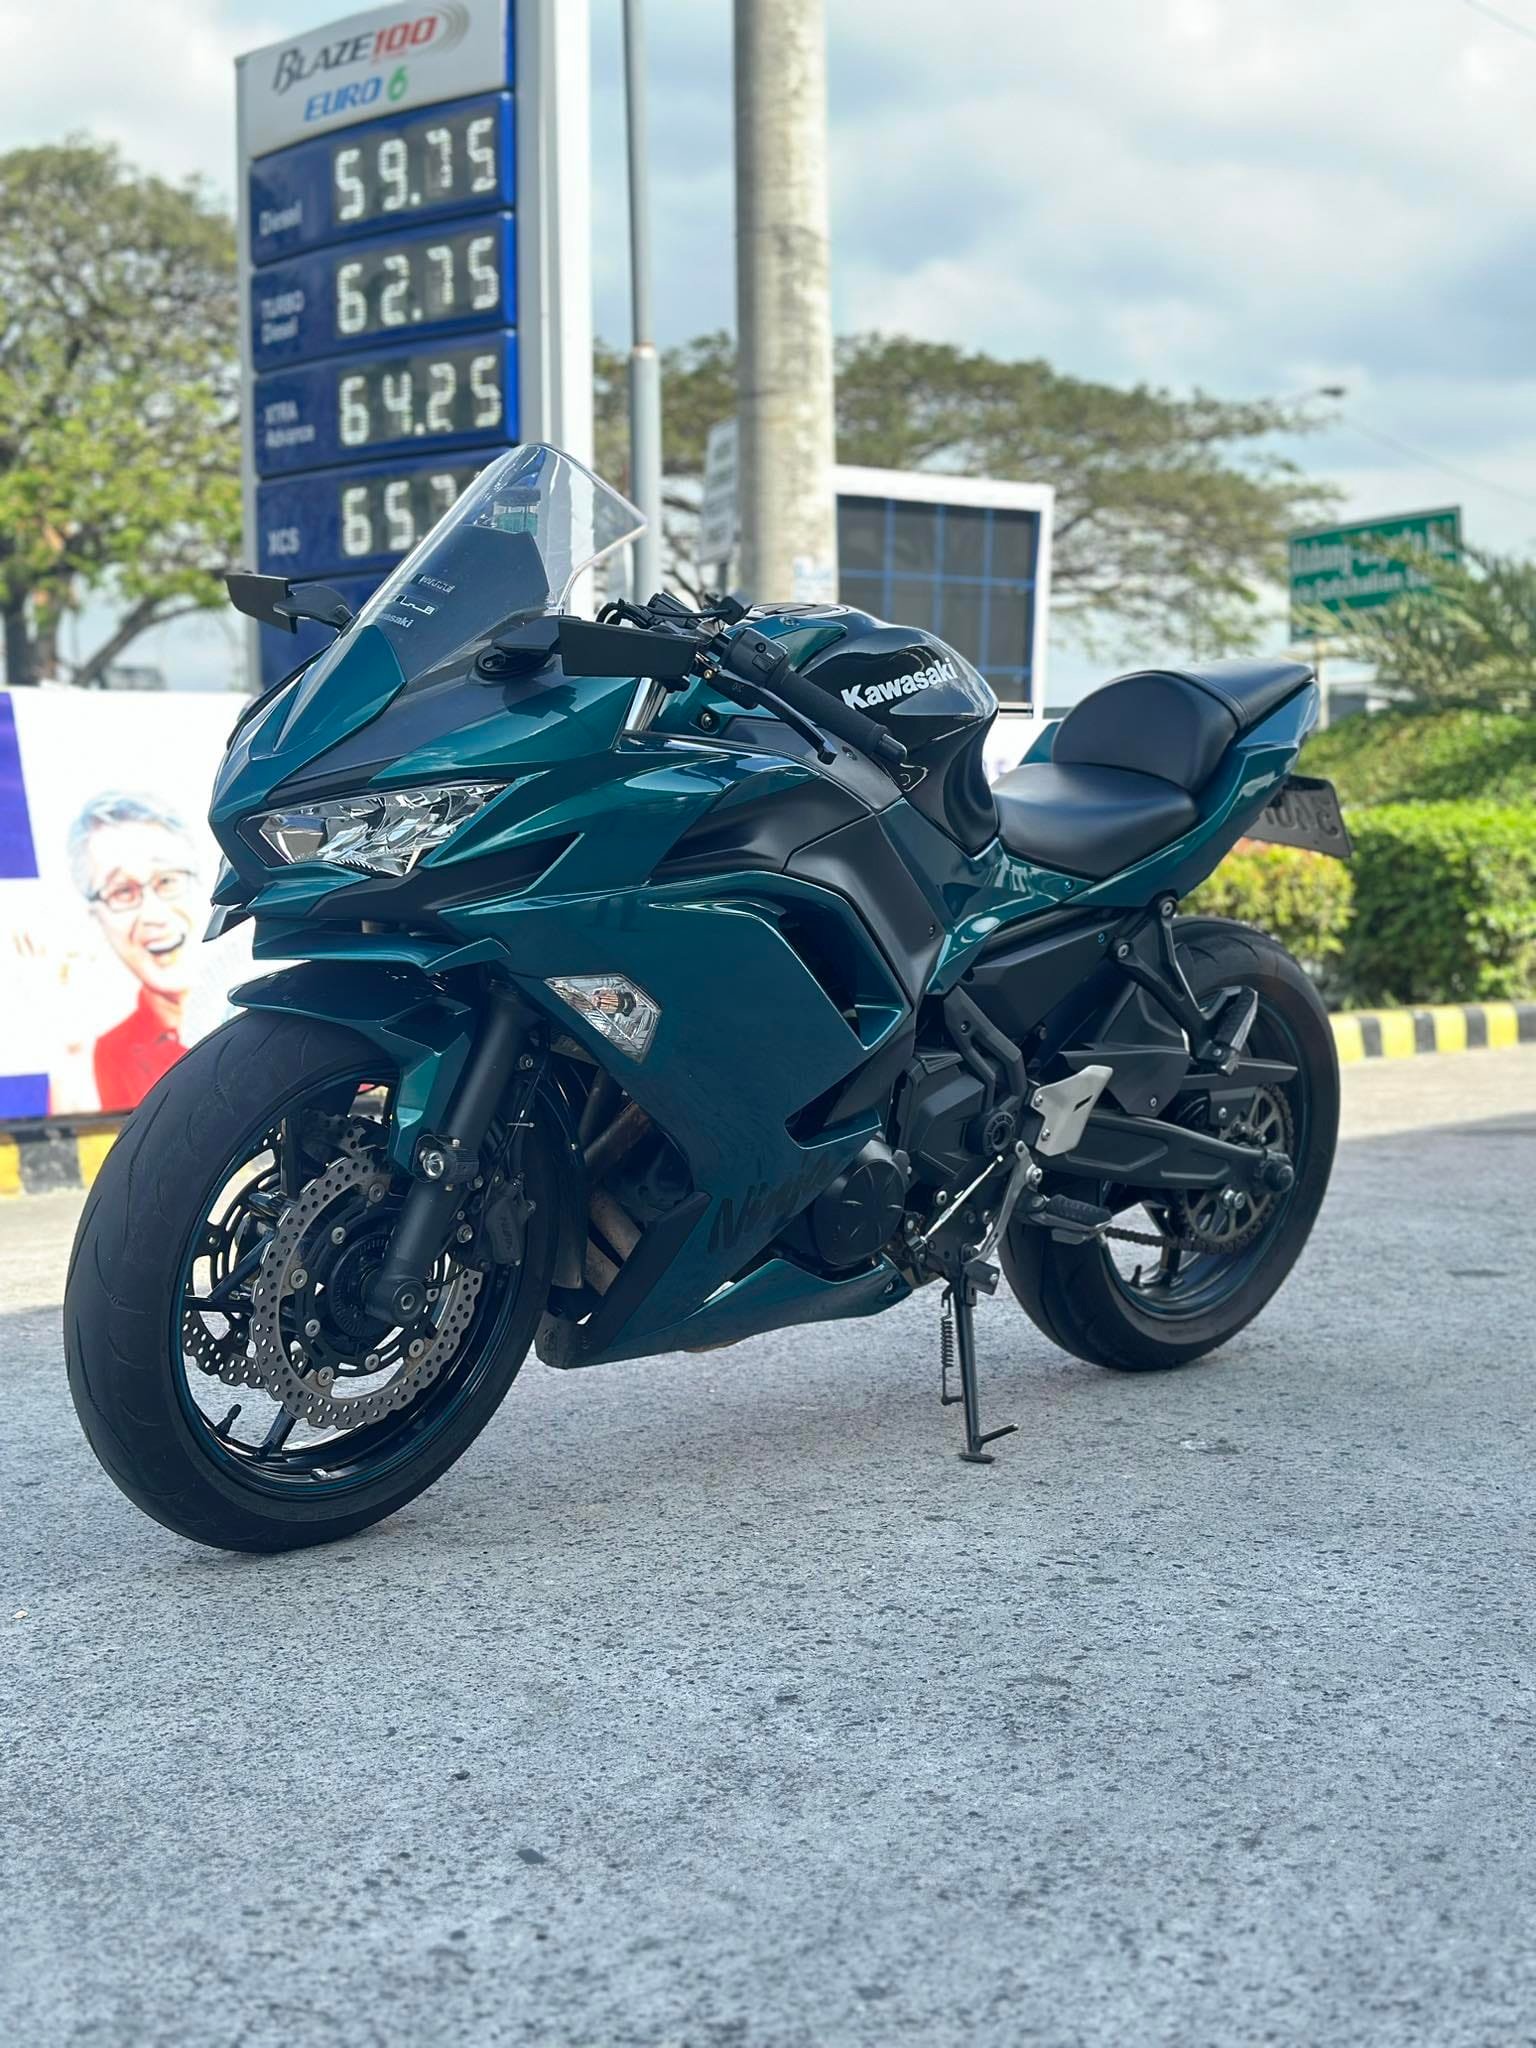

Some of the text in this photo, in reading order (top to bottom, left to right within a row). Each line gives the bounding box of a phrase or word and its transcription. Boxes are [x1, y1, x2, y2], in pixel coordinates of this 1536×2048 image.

[304, 64, 409, 122] EURO 6
[334, 116, 497, 220] 59.75
[337, 236, 499, 333] 62.75
[339, 354, 502, 446] 64.25
[267, 527, 301, 556] XCS
[840, 657, 959, 711] Kawasaki
